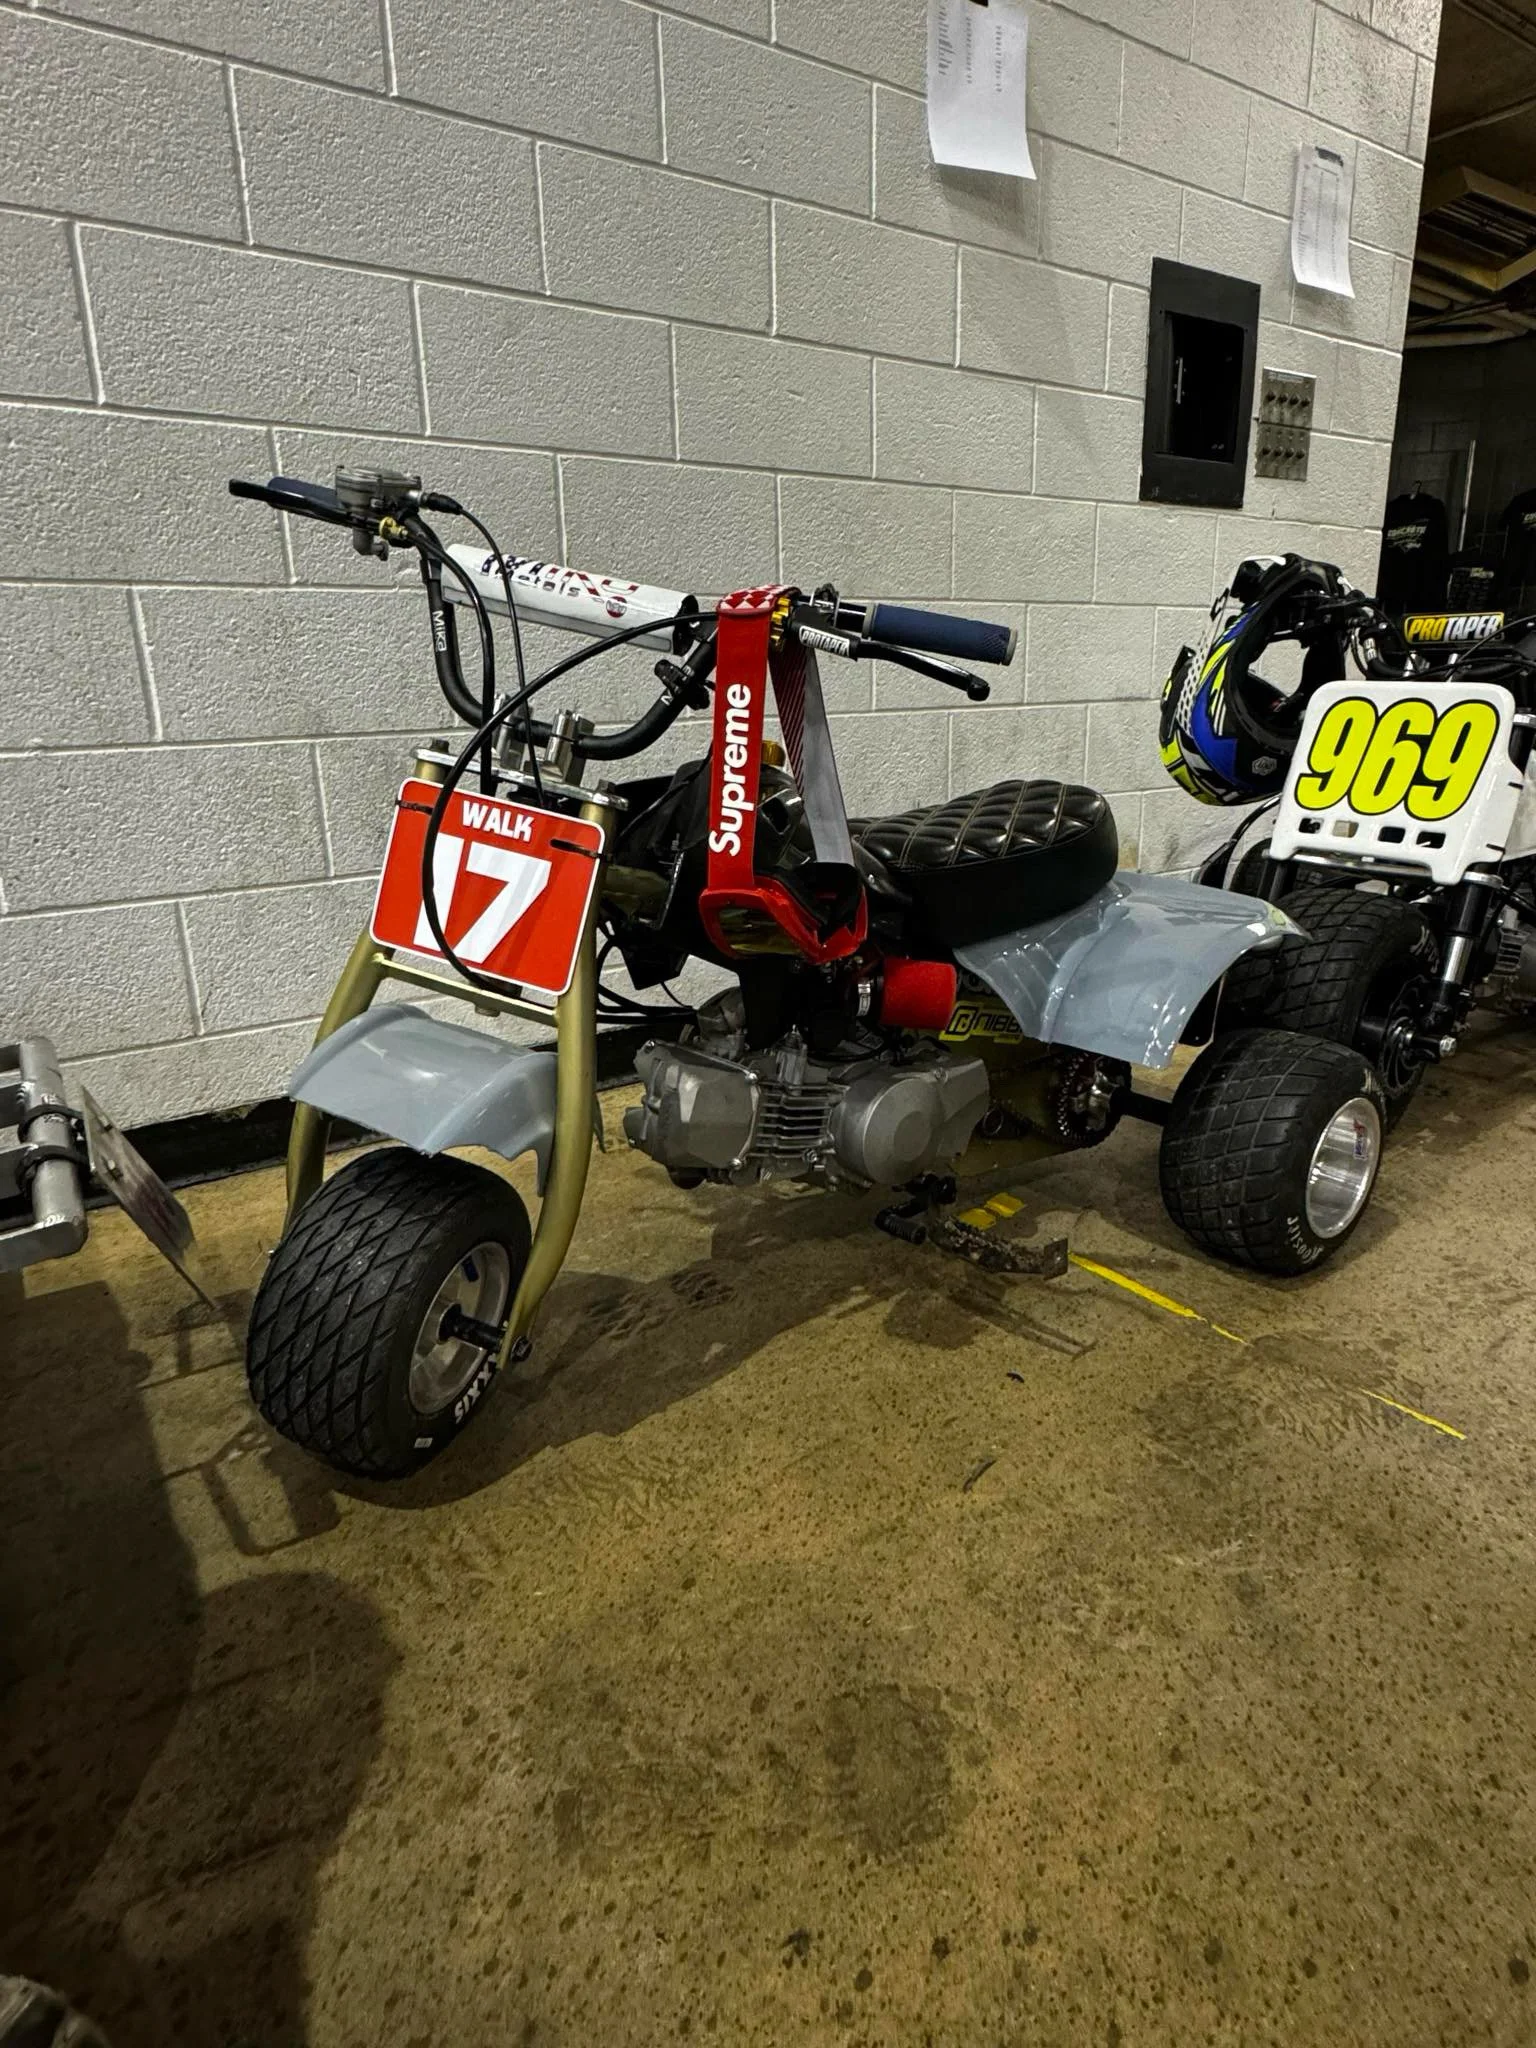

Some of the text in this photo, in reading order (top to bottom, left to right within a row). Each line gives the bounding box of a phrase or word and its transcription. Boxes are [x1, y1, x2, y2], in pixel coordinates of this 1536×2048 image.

[461, 800, 535, 842] WALK
[708, 683, 752, 857] Supreme
[1294, 696, 1501, 822] 969
[412, 832, 552, 964] 17
